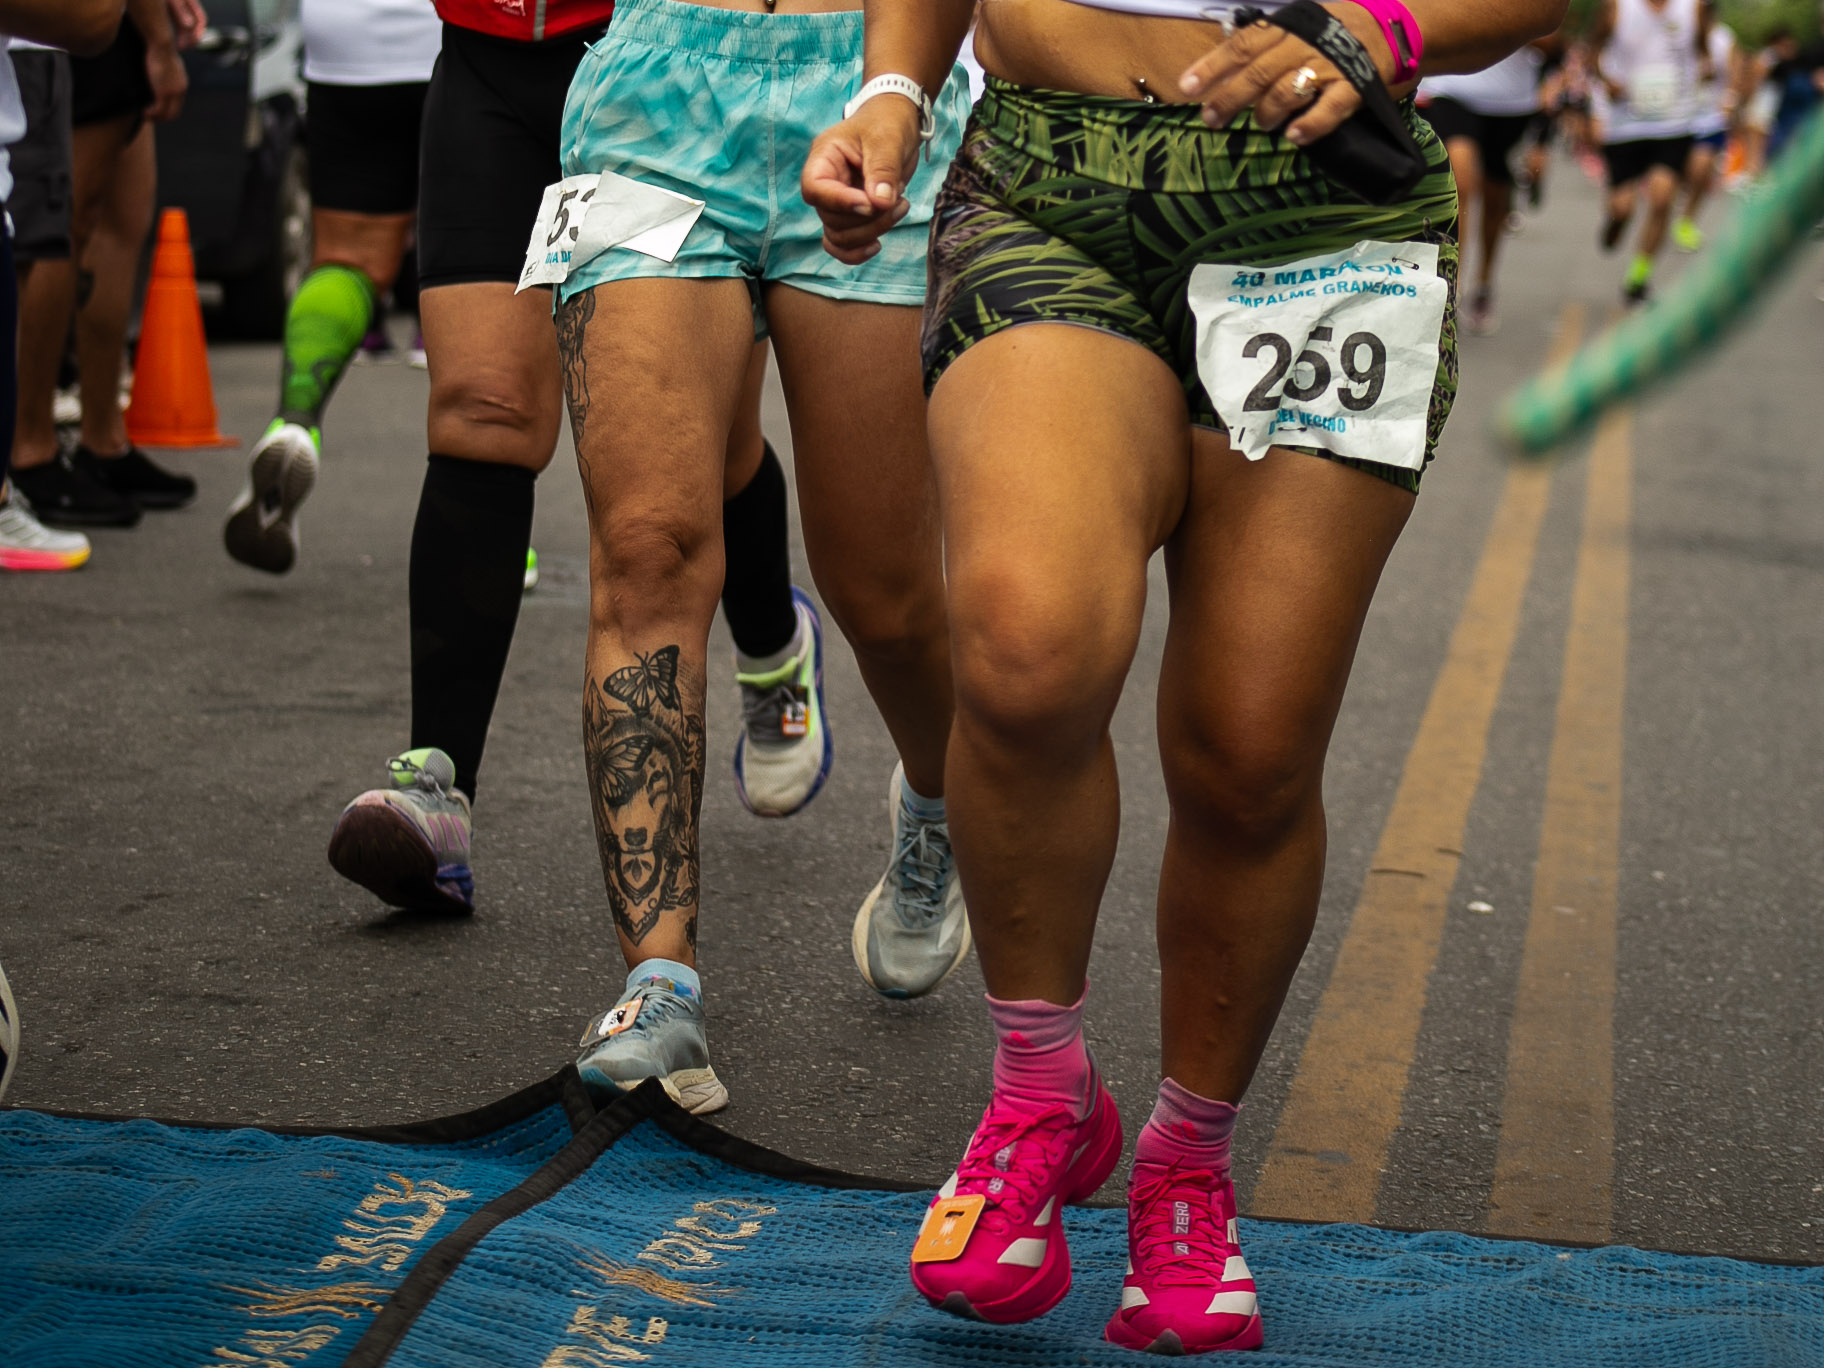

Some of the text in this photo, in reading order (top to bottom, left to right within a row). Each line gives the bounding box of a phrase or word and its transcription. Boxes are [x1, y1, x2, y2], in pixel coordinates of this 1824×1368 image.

[1227, 280, 1418, 309] EMPALME GRANEROS
[1231, 271, 1266, 289] 40
[1242, 326, 1387, 412] 259
[1174, 1200, 1191, 1256] AZERO
